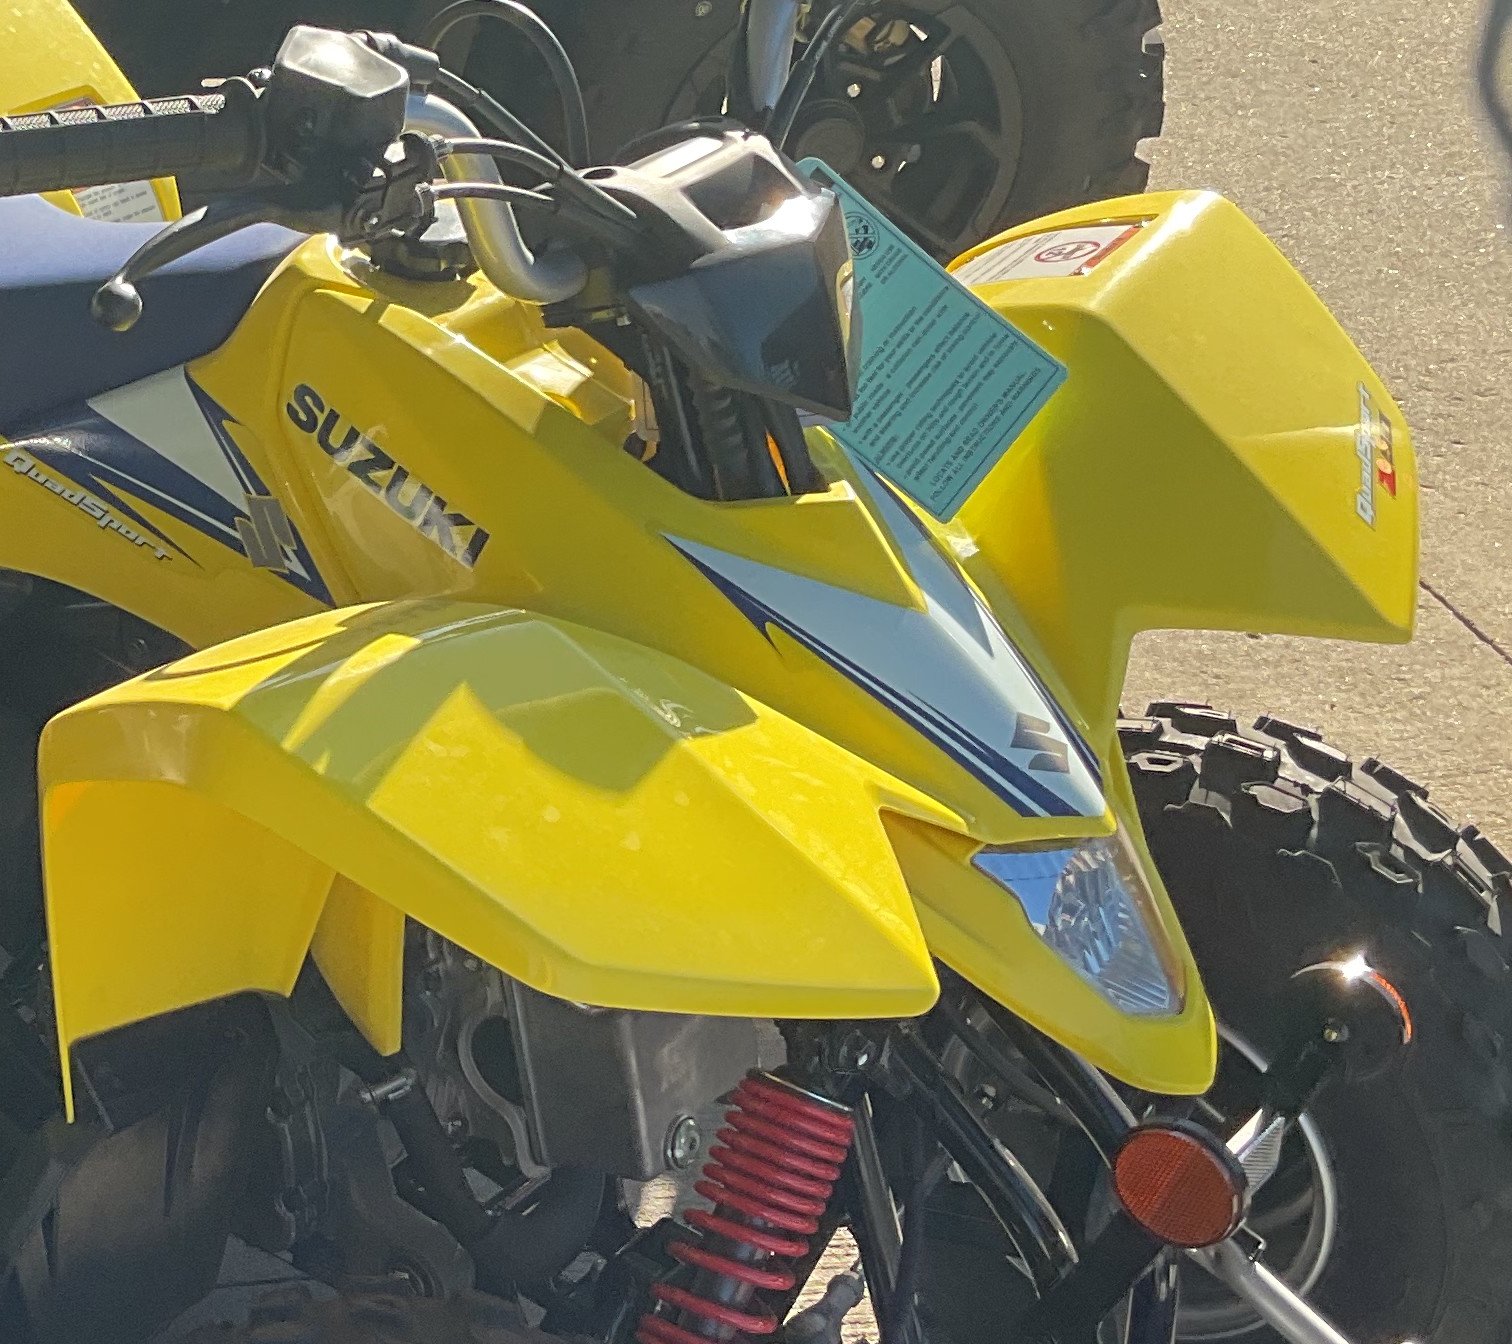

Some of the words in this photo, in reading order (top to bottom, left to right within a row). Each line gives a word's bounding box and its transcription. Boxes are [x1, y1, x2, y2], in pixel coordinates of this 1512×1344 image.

[3, 449, 173, 561] QuadSport
[286, 383, 490, 569] SUZUKI
[1355, 381, 1376, 529] QuadSport
